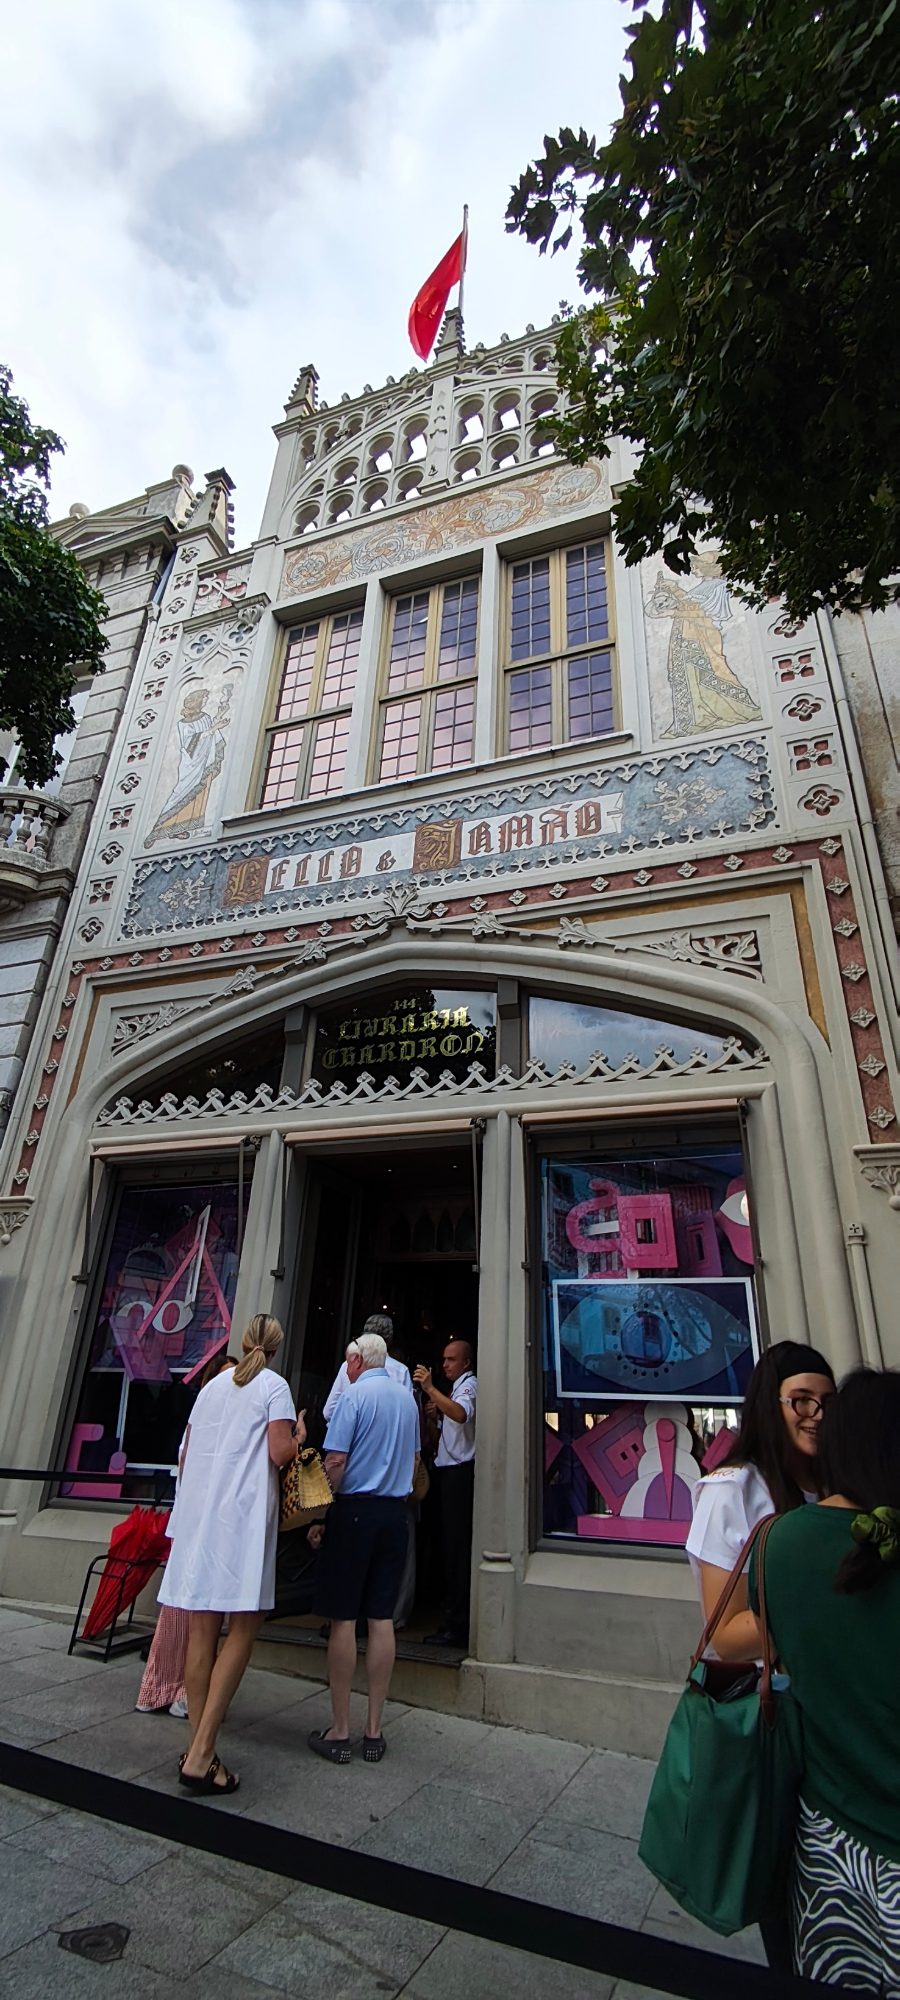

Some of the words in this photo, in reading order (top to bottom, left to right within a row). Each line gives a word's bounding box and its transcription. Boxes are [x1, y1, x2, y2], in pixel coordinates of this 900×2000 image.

[225, 845, 363, 902] LELLO
[375, 849, 397, 872] &
[338, 1006, 472, 1041] LIVRARIA
[321, 1031, 485, 1070] CHARDRON
